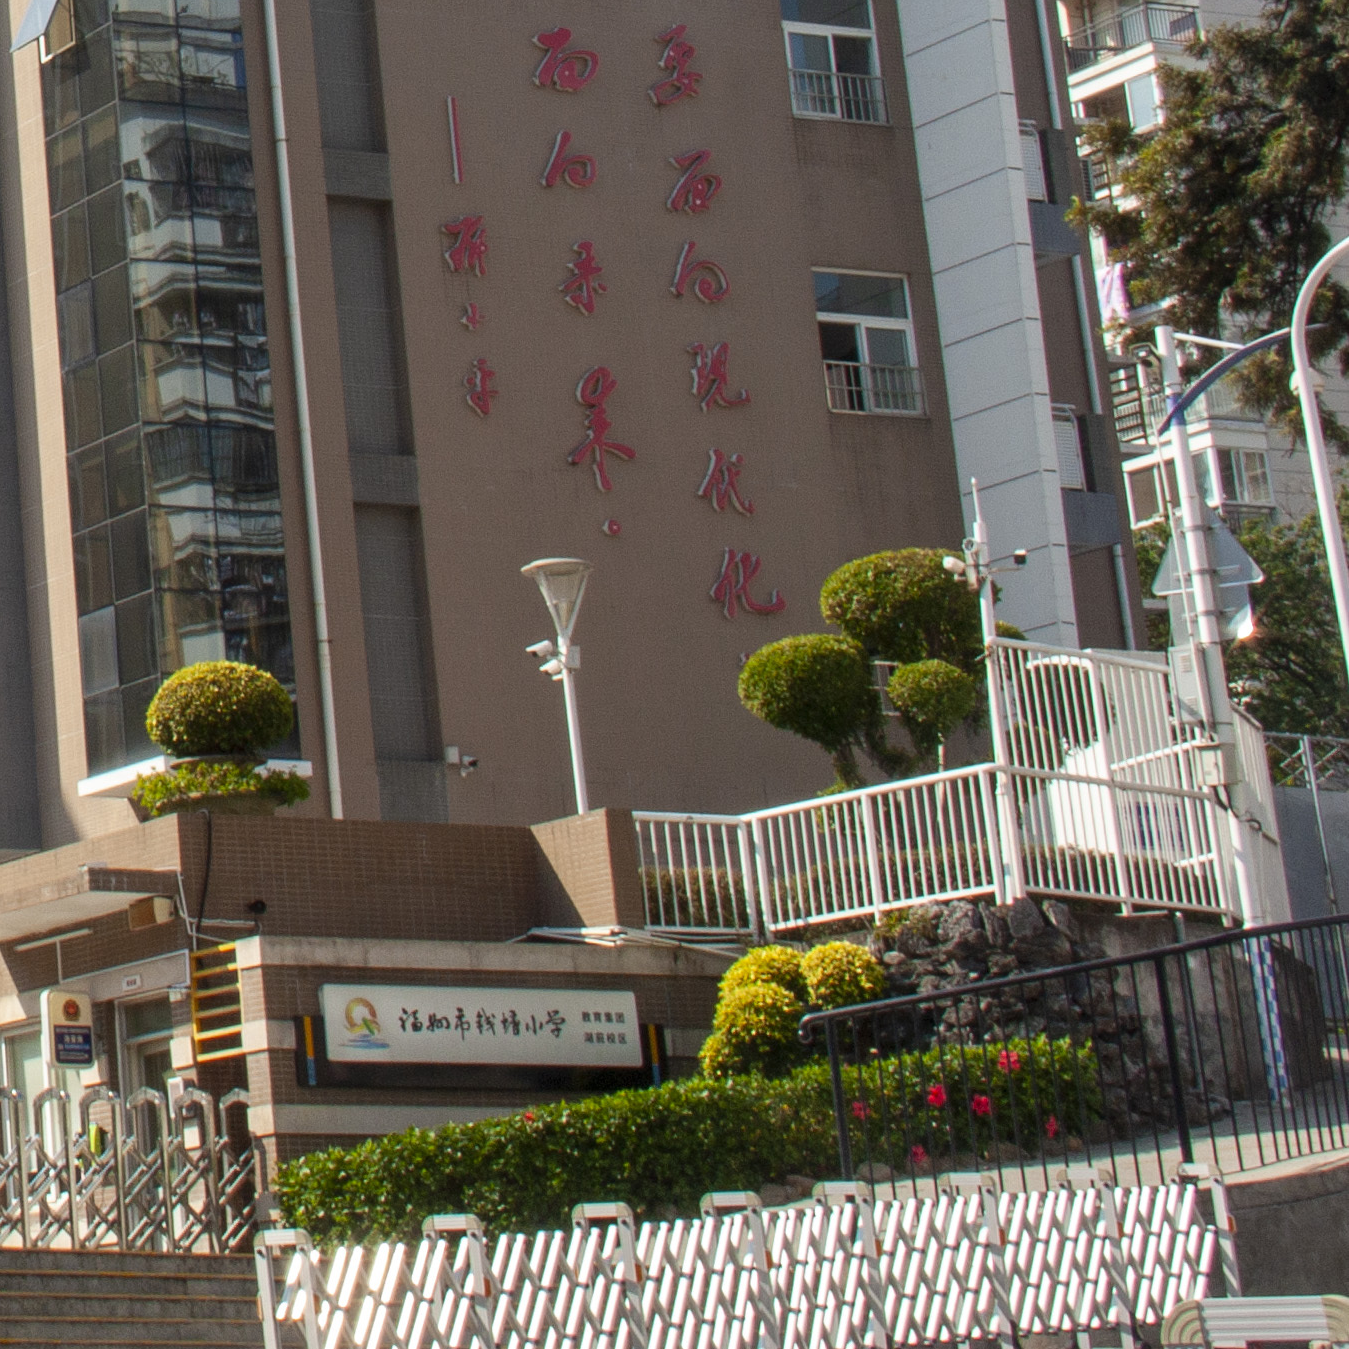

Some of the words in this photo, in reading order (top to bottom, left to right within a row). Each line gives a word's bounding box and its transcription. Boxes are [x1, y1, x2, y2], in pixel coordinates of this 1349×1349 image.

[398, 1006, 566, 1042] 福州市钱塘小学
[581, 1011, 626, 1025] 教育集团
[583, 1031, 628, 1045] 湖前校区
